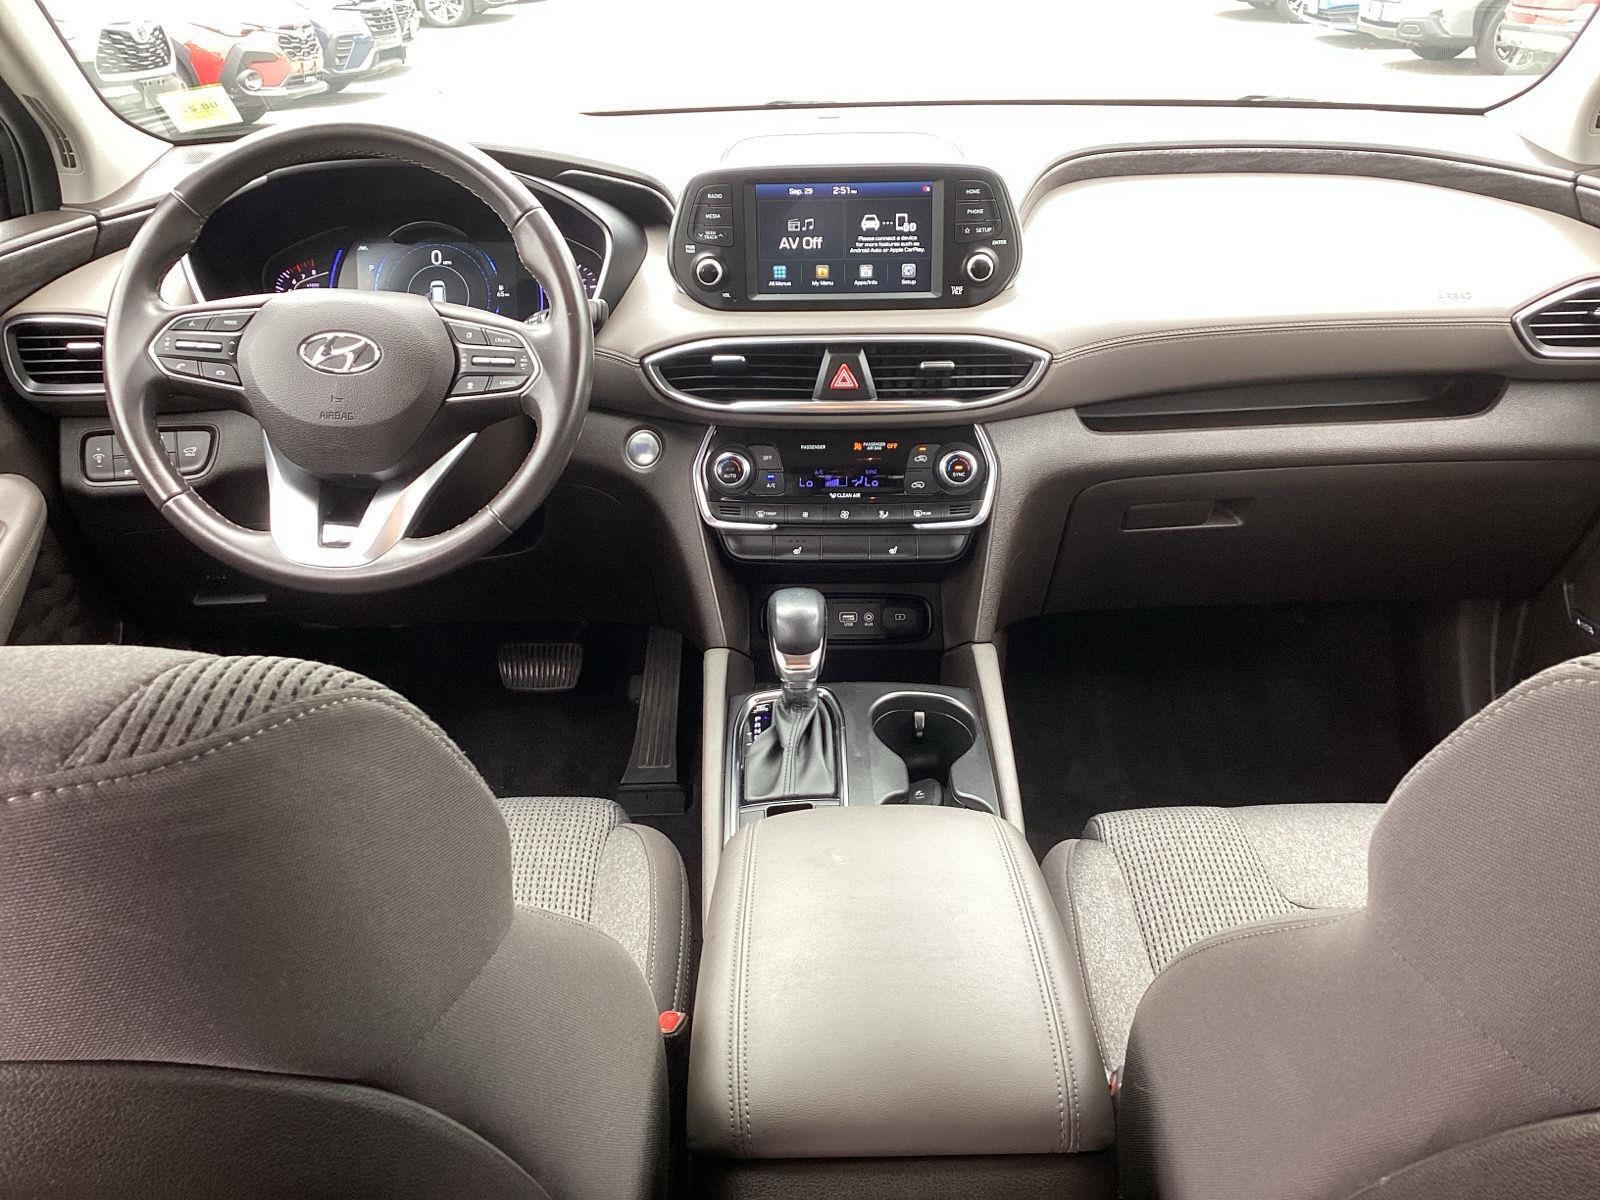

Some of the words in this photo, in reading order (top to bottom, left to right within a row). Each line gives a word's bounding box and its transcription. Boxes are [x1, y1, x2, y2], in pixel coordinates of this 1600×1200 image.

[788, 187, 803, 196] Sep.
[832, 186, 850, 194] 2:51
[778, 236, 800, 250] AV
[802, 236, 823, 250] Off
[430, 249, 442, 265] 0
[320, 410, 354, 420] AIRBAG
